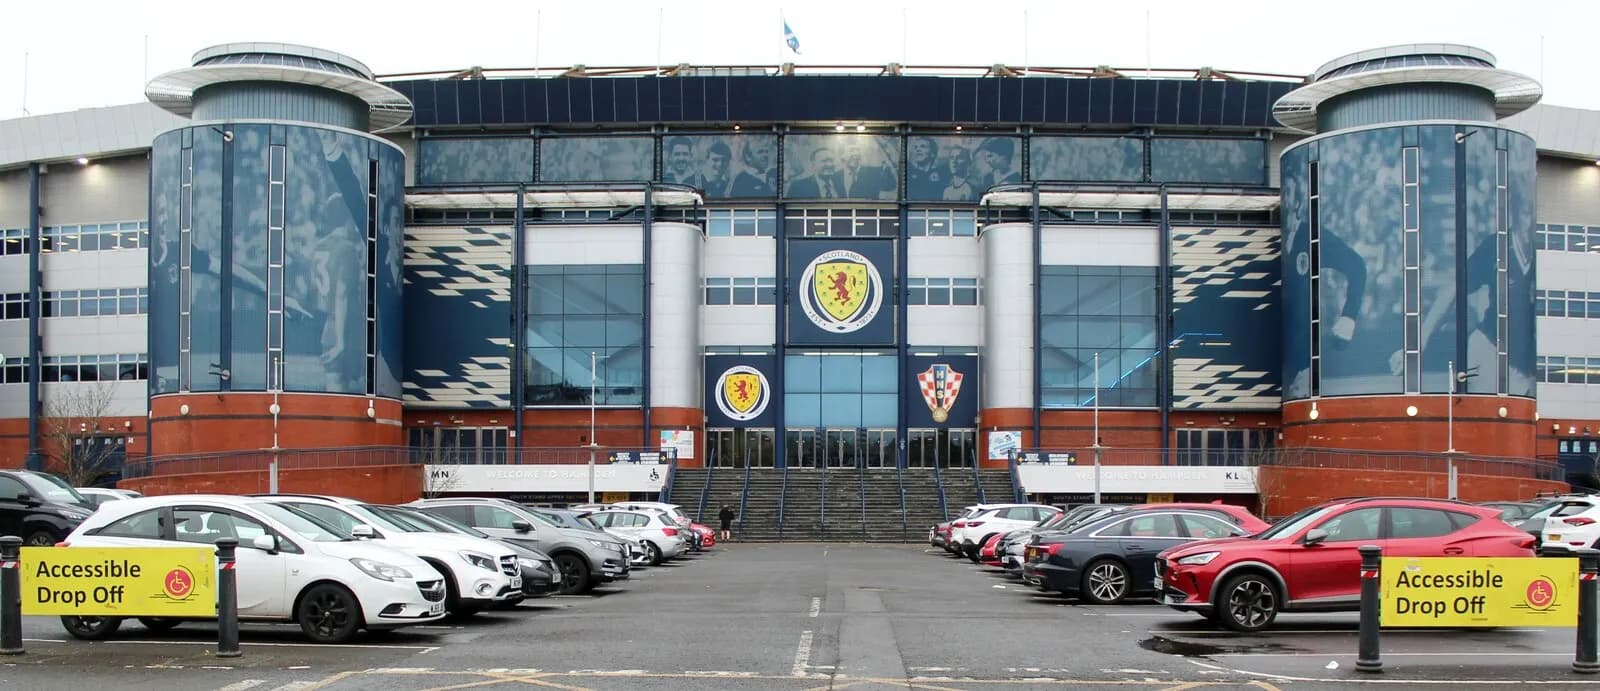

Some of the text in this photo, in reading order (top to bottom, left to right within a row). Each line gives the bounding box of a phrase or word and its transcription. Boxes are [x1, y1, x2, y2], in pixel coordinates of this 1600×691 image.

[822, 251, 860, 261] SCOTLAND
[936, 370, 945, 399] HNS
[486, 470, 541, 480] WELCOME
[562, 470, 617, 481] HAMDEN
[1075, 471, 1129, 481] WEOME
[37, 560, 140, 577] Accessible
[1396, 570, 1502, 587] Accessible
[38, 586, 124, 607] Drop Off
[1397, 596, 1485, 618] Drop Off
